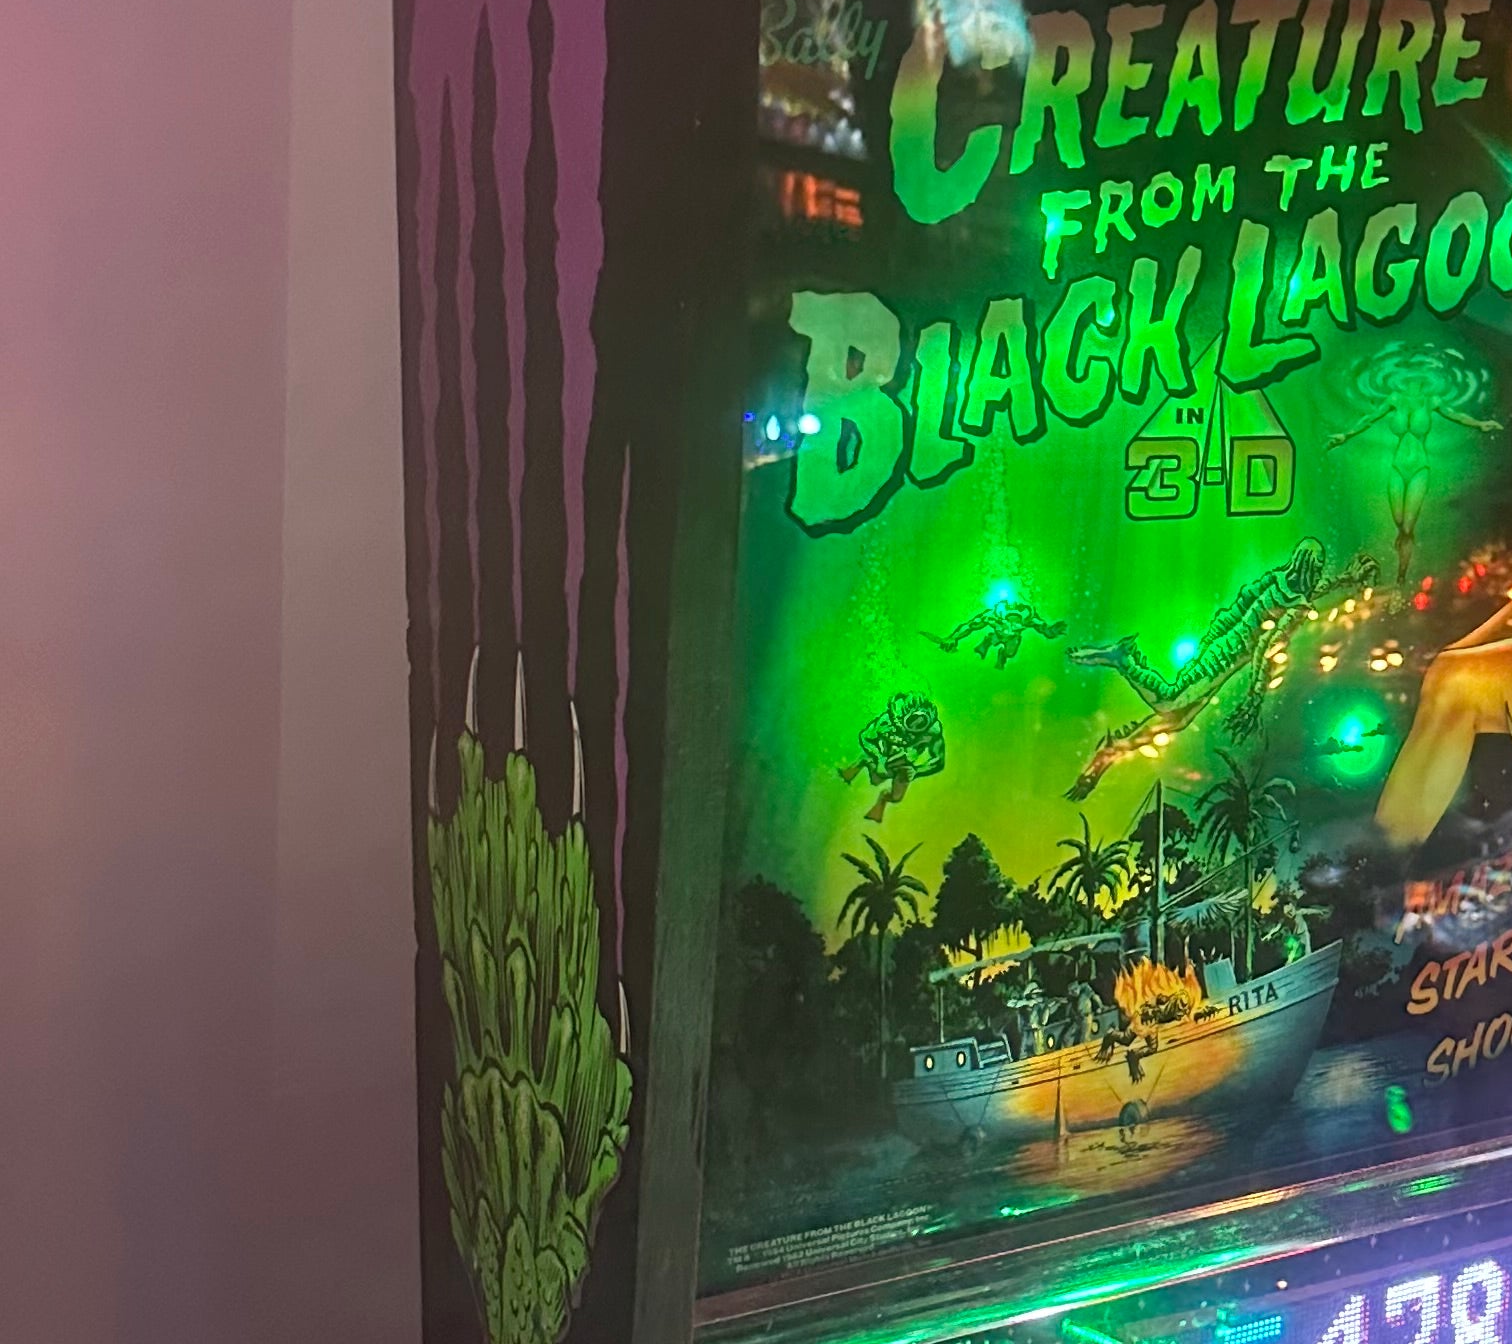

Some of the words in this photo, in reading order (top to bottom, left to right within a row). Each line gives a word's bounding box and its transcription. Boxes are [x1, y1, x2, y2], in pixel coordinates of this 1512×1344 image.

[1040, 164, 1235, 279] FROM
[1265, 142, 1392, 211] THE
[787, 248, 1200, 533] BLACK
[1175, 406, 1204, 425] IN
[1126, 435, 1296, 518] 3-D
[1228, 980, 1279, 1017] RITA
